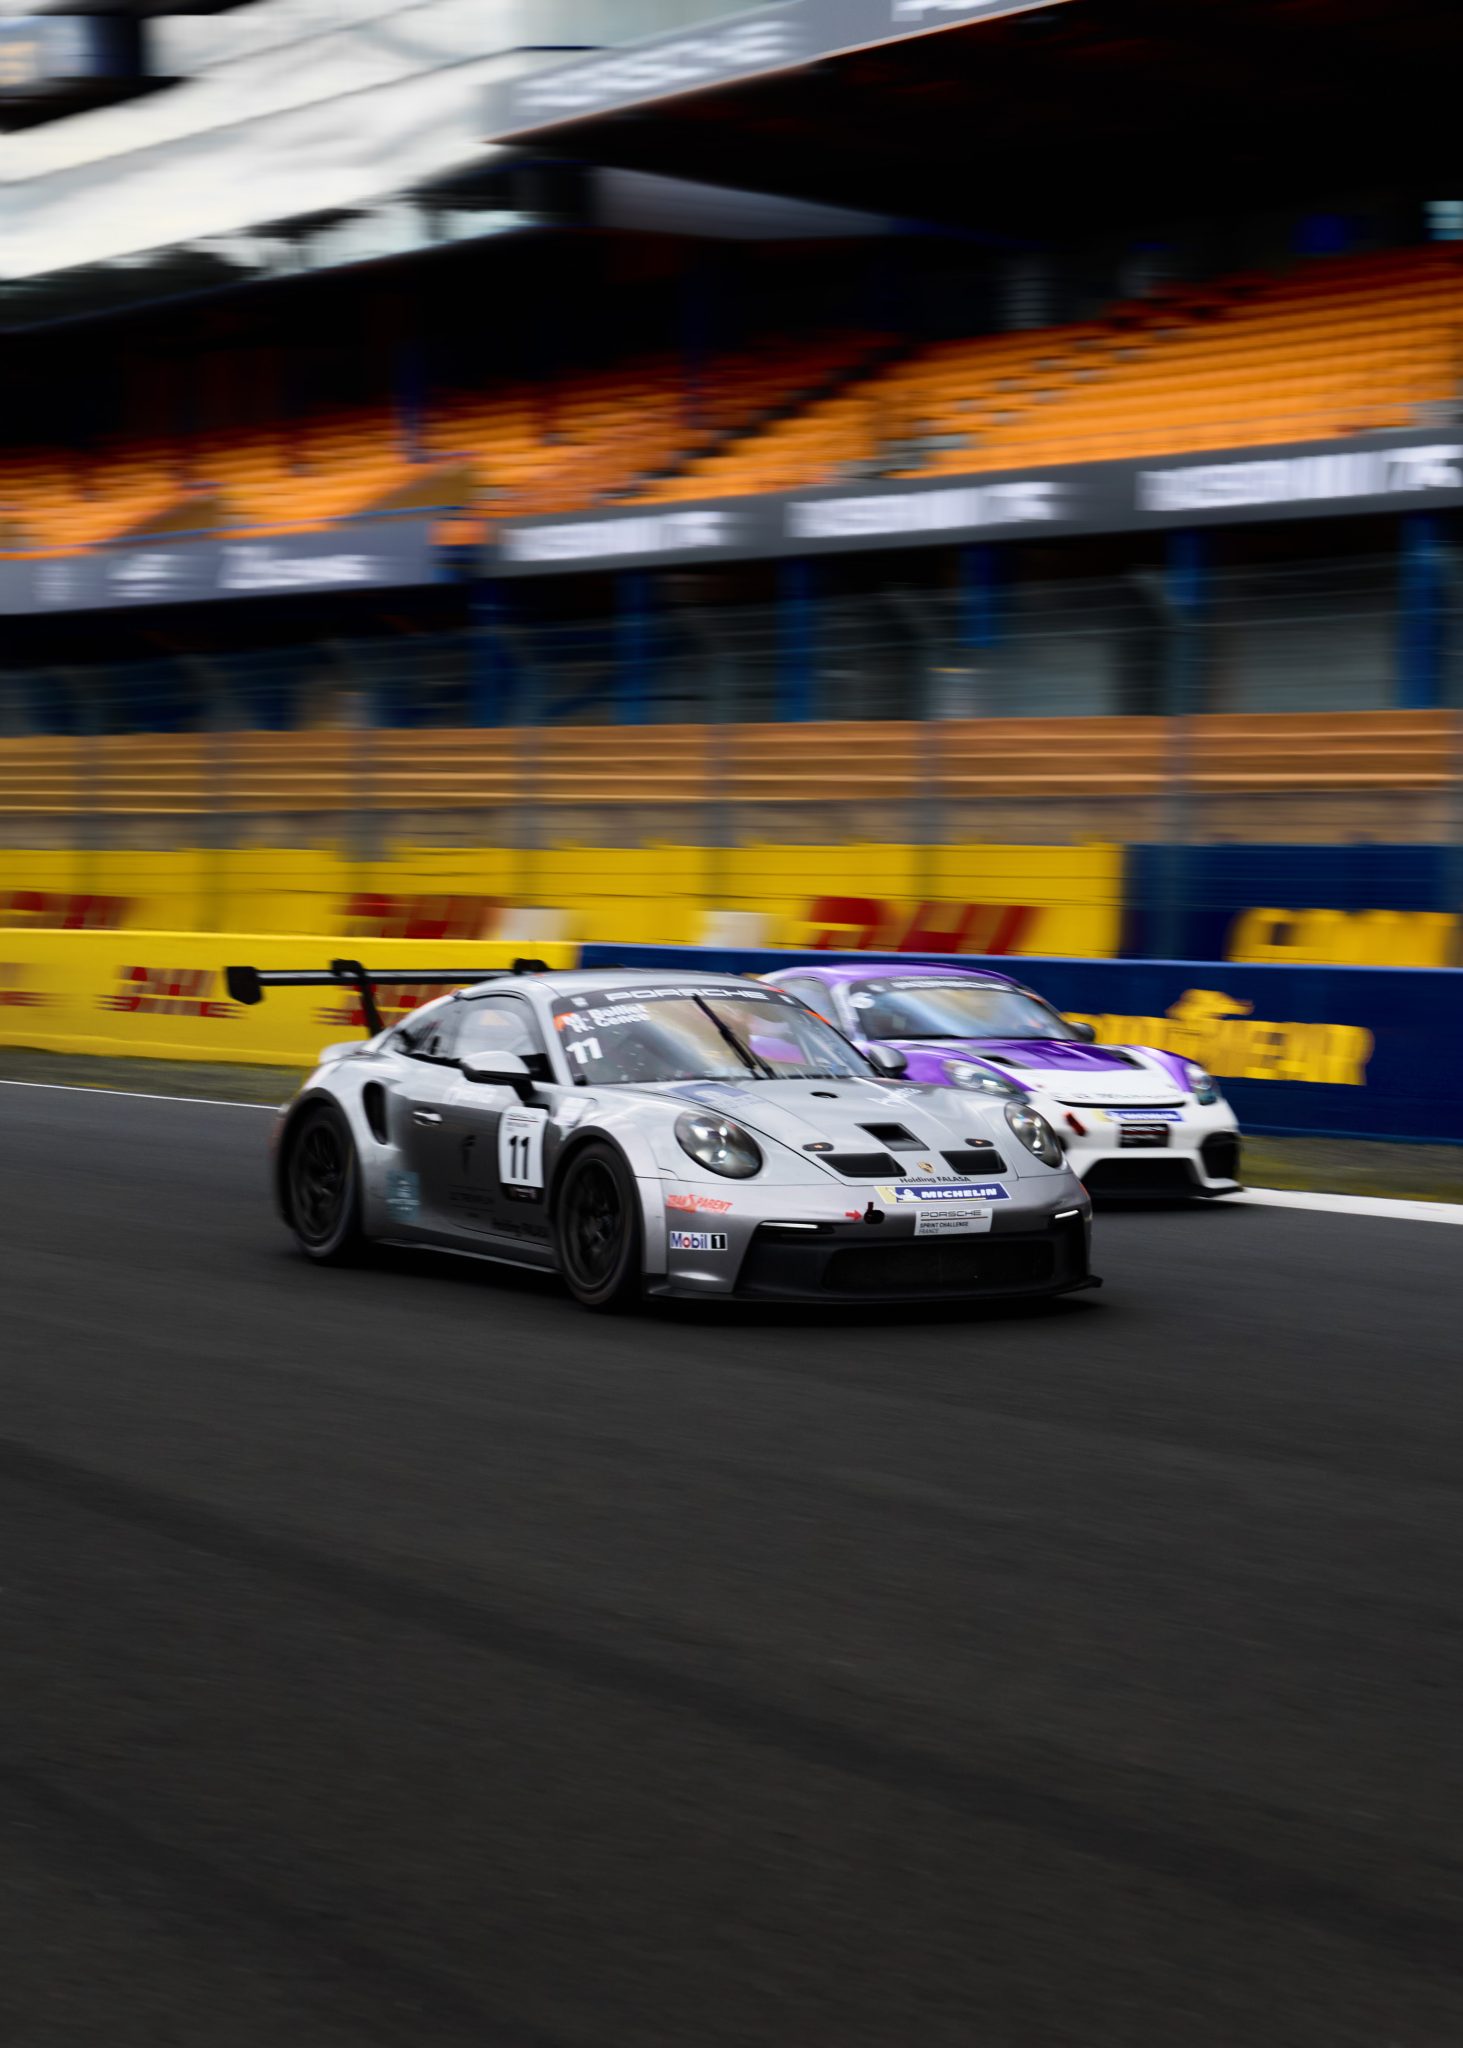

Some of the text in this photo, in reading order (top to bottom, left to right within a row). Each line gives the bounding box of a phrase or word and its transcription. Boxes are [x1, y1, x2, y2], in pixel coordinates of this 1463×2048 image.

[605, 987, 770, 1001] PORSCHE
[565, 1037, 603, 1064] 11
[508, 1135, 531, 1180] 11
[900, 1176, 936, 1184] Holding
[921, 1188, 998, 1198] MICHELIN
[920, 1209, 982, 1218] PORSCHE
[671, 1232, 708, 1249] Mobil
